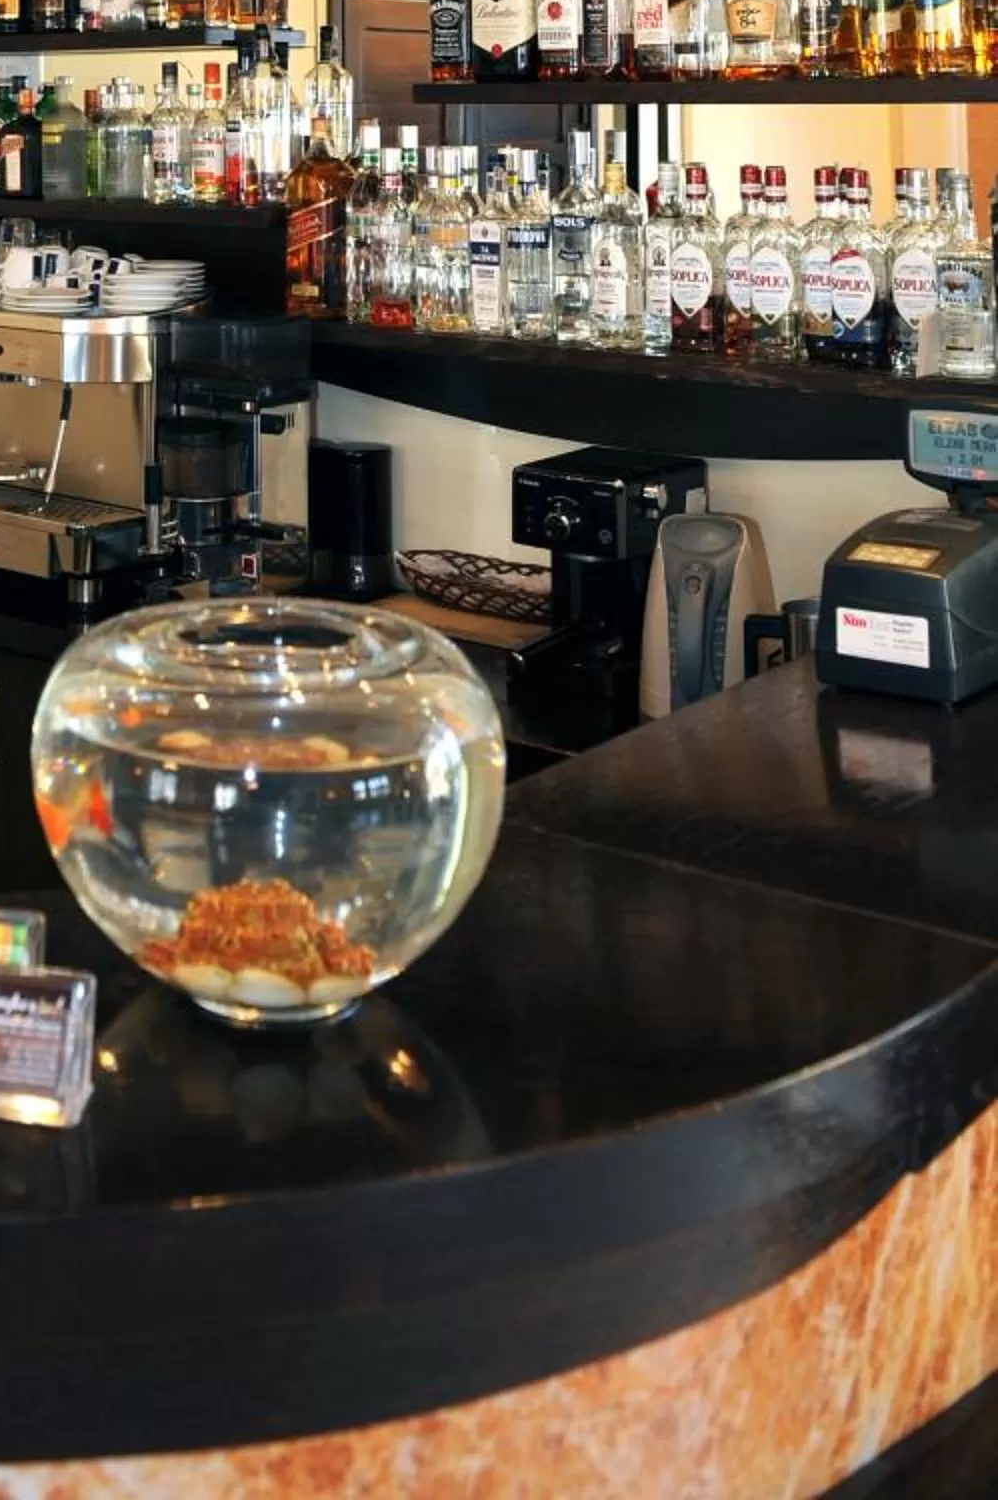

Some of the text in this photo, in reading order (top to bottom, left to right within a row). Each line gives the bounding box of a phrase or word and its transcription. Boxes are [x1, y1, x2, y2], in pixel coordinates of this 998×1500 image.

[637, 4, 663, 21] red
[553, 216, 586, 228] BOLS
[671, 271, 709, 284] SOPLICA
[726, 269, 751, 282] SOPL
[751, 276, 790, 288] SOPLICA
[802, 273, 832, 287] SOPLI
[831, 278, 871, 293] SOPLICA
[894, 277, 936, 293] SOPLICA
